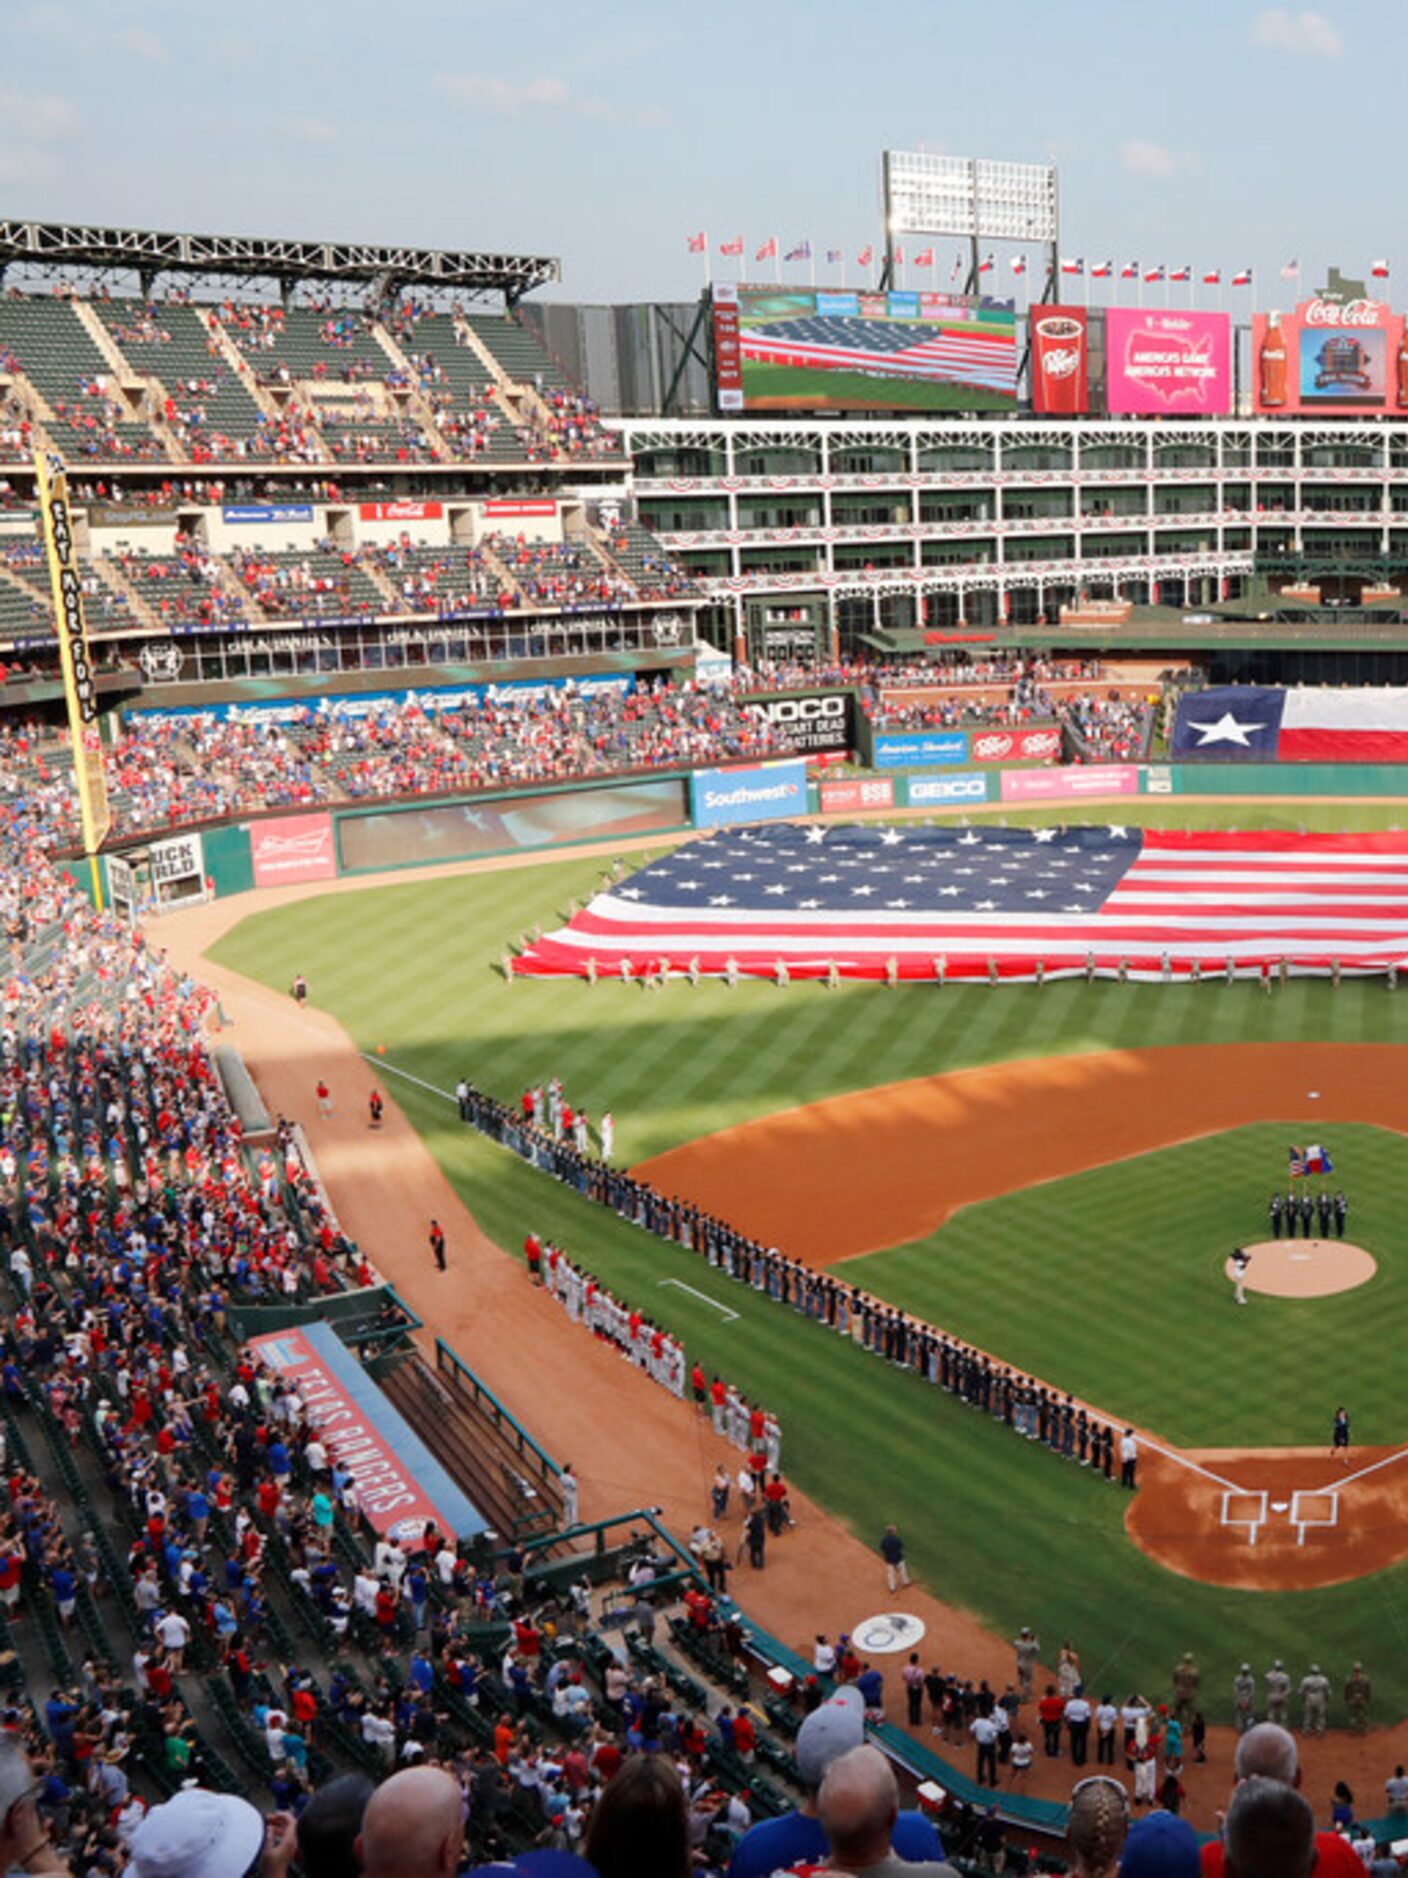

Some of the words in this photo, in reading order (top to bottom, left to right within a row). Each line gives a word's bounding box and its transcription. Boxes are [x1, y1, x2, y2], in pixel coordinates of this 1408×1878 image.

[704, 784, 787, 809] Southwest
[909, 780, 986, 799] GEICO
[322, 1425, 417, 1514] RANGERS
